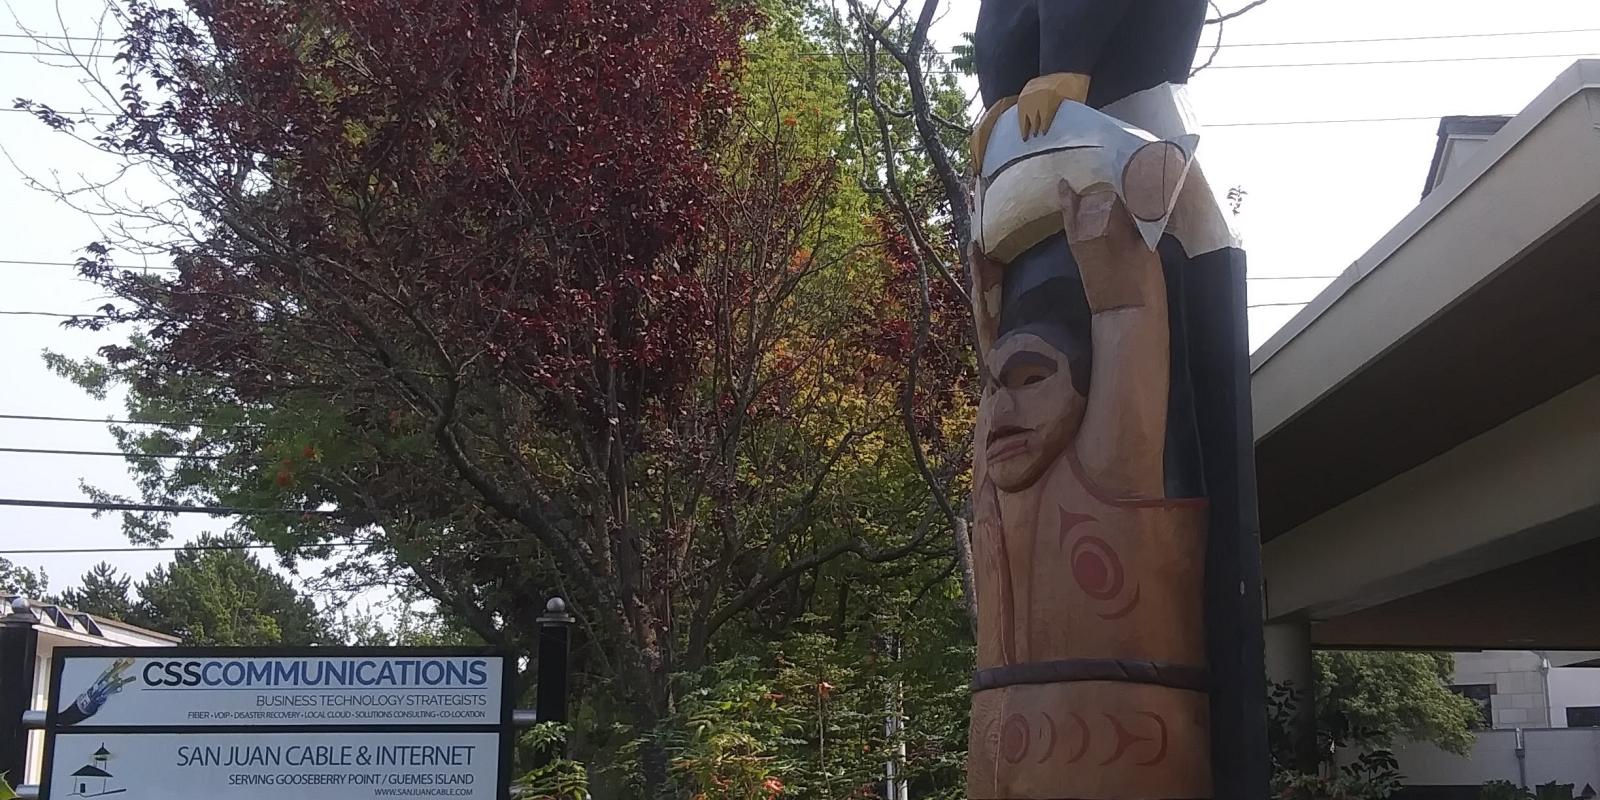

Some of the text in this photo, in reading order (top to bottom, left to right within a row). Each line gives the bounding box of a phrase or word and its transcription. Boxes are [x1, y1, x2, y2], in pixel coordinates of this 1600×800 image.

[256, 694, 487, 707] BUSINESS TECHNOLOGY STRATEGISTS
[187, 710, 486, 720] FIBER VOIP DISASTER RECOVERY LOCAL CLOUD SOLUTIONS CONSULTING CO-LOCATION
[176, 745, 476, 766] SAN JUAN CABLE & INTERNET
[228, 773, 474, 785] SERVING GOOSEBERRY POINT / GUEMES ISLAND
[374, 788, 473, 796] WWW.SANJUANCABLE.COM
